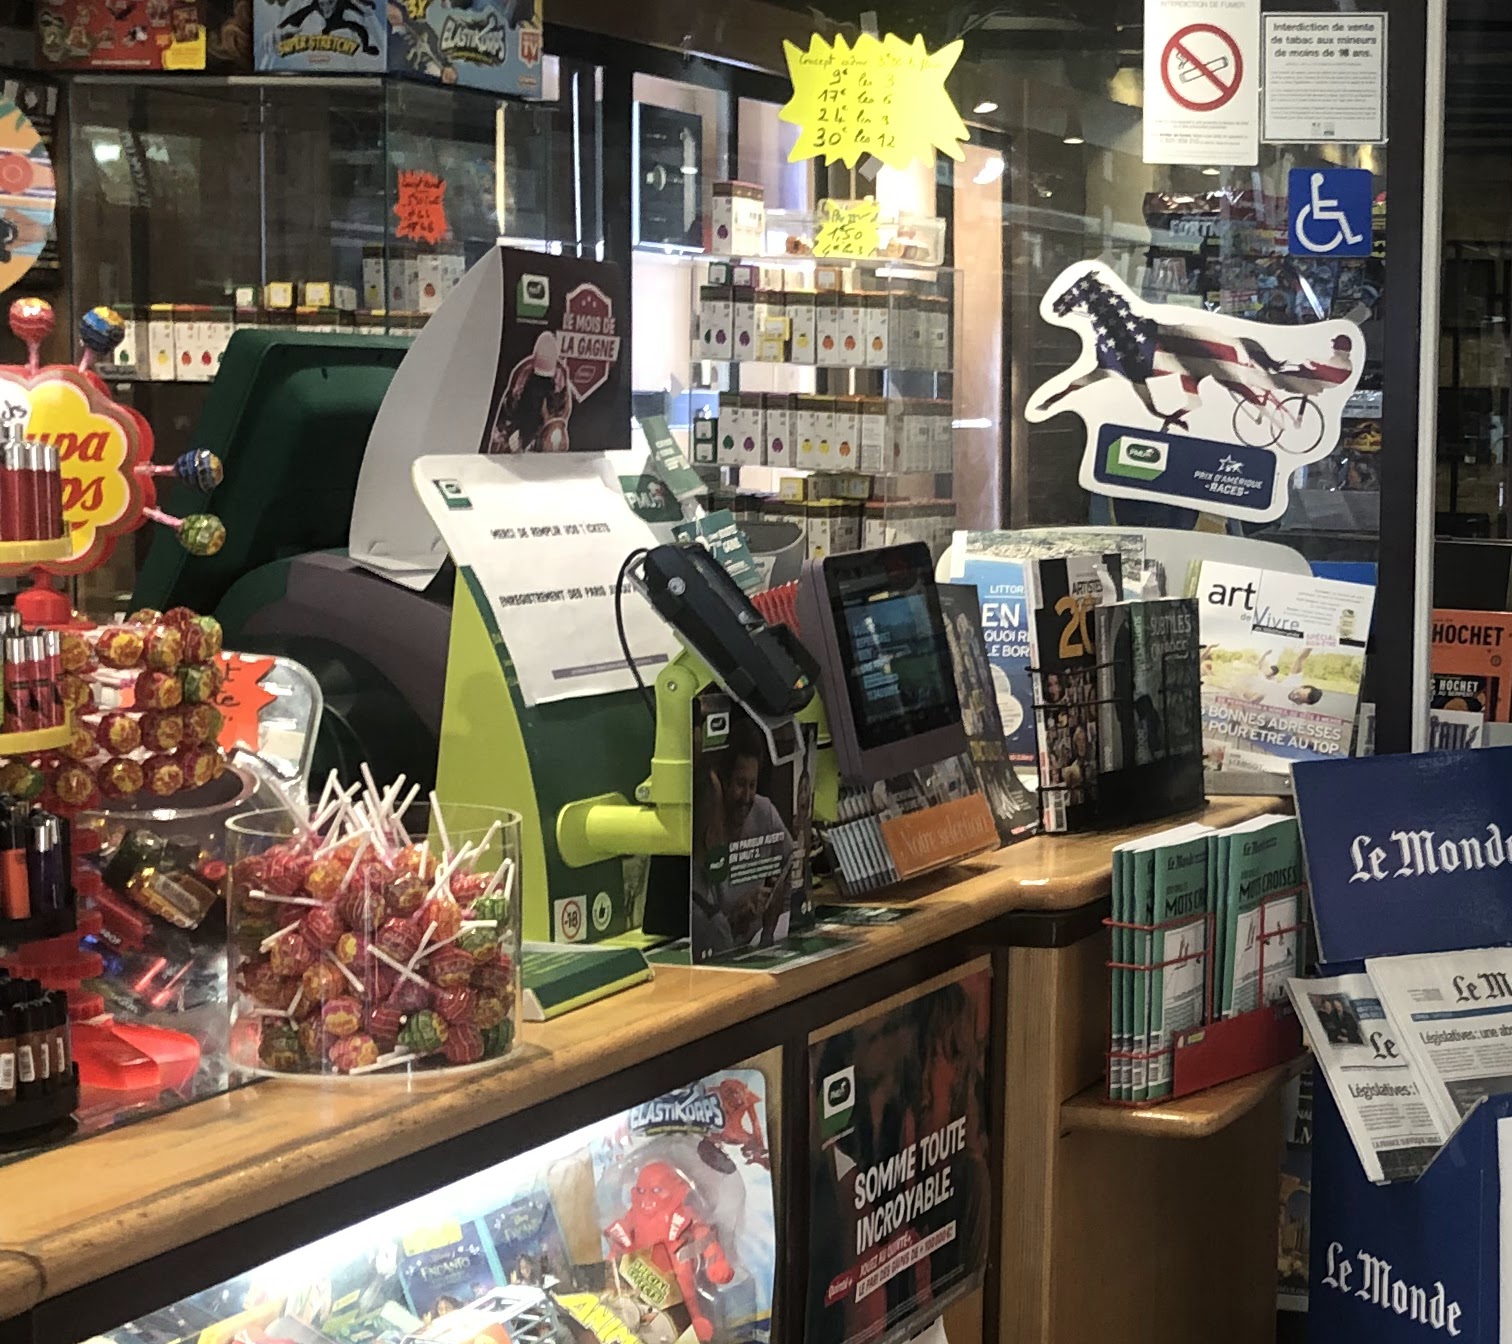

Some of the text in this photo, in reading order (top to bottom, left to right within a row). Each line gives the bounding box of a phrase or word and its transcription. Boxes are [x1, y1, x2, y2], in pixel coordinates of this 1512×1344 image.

[1273, 23, 1375, 32] Interdiction de vente
[1271, 36, 1283, 44] de
[1286, 36, 1313, 44] tabac
[1337, 36, 1376, 44] mineurs
[1275, 48, 1287, 57] de
[1289, 48, 1319, 57] moins
[1322, 48, 1335, 57] de
[1338, 48, 1349, 57] 18
[878, 134, 895, 148] 12
[563, 313, 615, 334] LE MOIS DE
[561, 337, 615, 357] LA GAGNE
[1194, 471, 1213, 480] PRIX
[490, 528, 516, 540] MERCI
[518, 528, 529, 538] DE
[531, 525, 562, 537] REMPLIR
[499, 584, 607, 607] ENREGISTREMENT DES PARIS
[1208, 582, 1256, 611] art
[982, 604, 1020, 628] EN
[1254, 606, 1299, 631] Vivre
[985, 630, 1017, 642] QUOI
[1439, 681, 1478, 693] HOCHET
[1208, 705, 1266, 727] BONNES
[1267, 718, 1342, 740] ADRESSES
[1208, 720, 1340, 755] POUR ÊTRE AU TOP
[1349, 835, 1390, 883] Le
[1453, 974, 1481, 1003] Le
[1479, 1026, 1498, 1039] une
[1369, 1032, 1400, 1059] Le
[631, 1094, 724, 1131] ELASTIKORPS
[854, 1115, 967, 1211] SOMME TOUTE
[856, 1165, 955, 1256] INCROYABLE.
[1321, 1241, 1462, 1337] Le Monde
